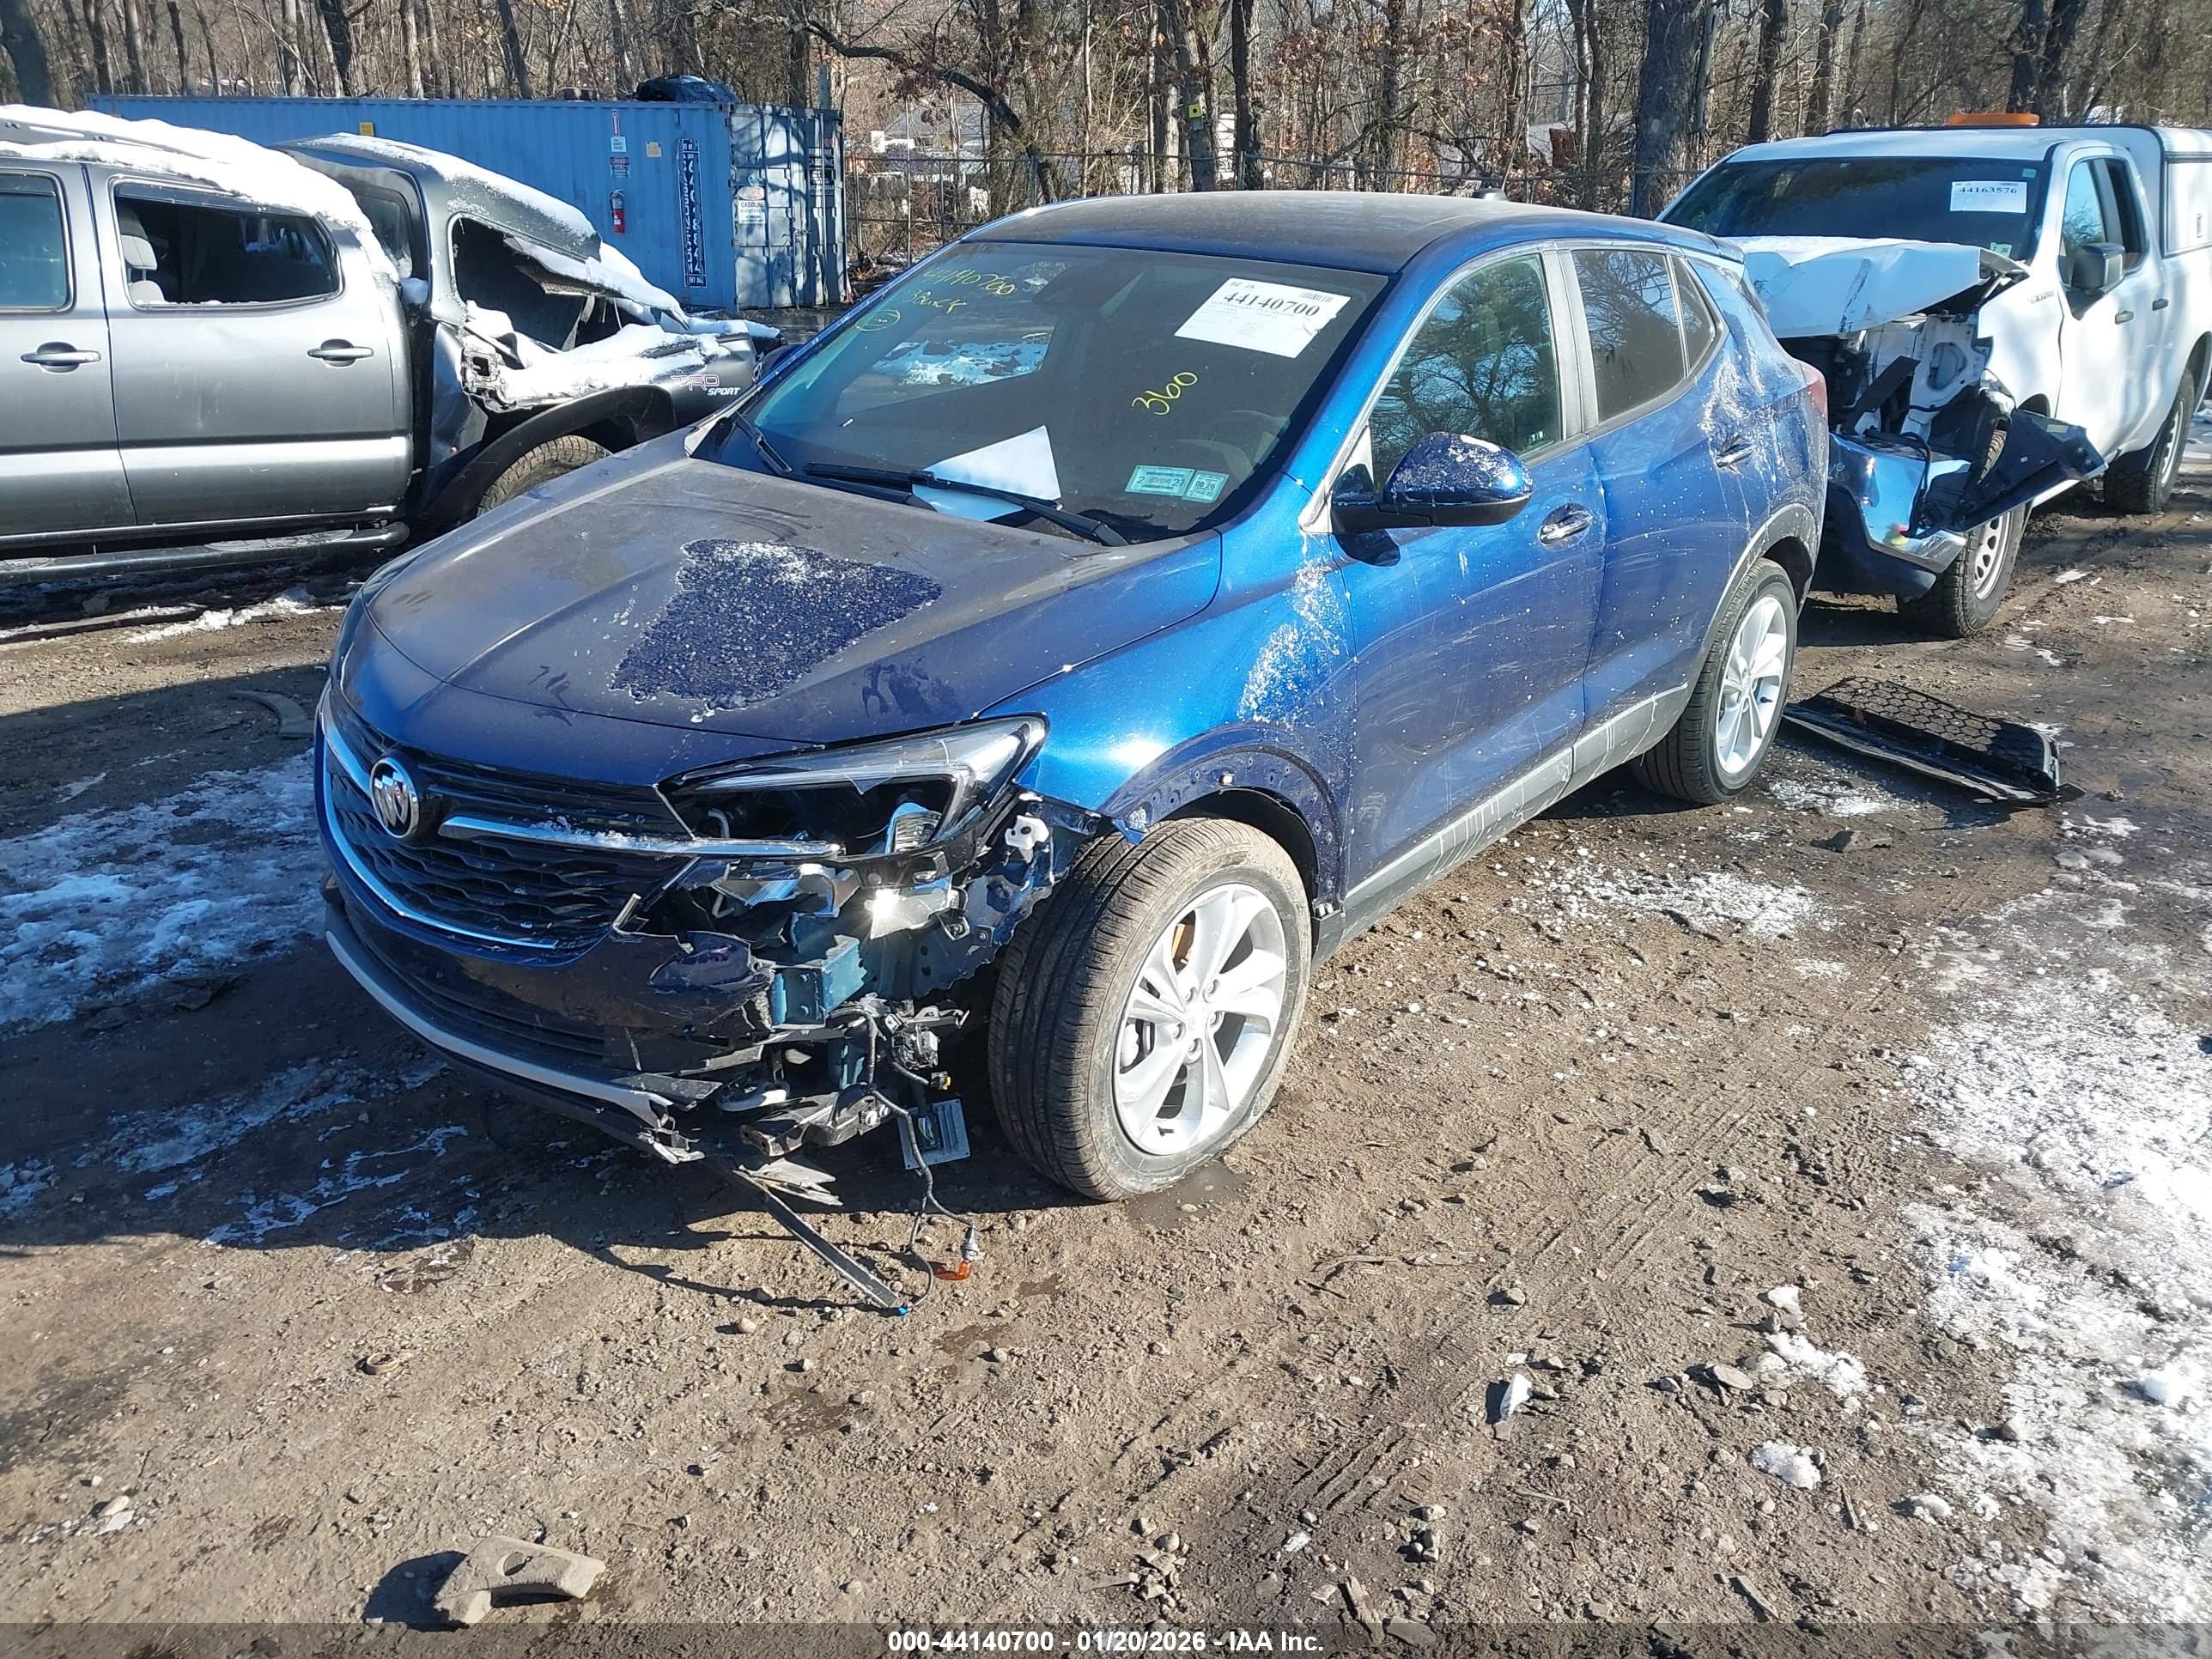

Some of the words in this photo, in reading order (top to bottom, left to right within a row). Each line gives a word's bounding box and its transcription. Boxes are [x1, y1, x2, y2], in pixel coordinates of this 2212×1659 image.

[1223, 291, 1321, 317] 44140700
[671, 374, 720, 392] TRD
[707, 387, 741, 396] SPORT
[1131, 371, 1199, 416] 360
